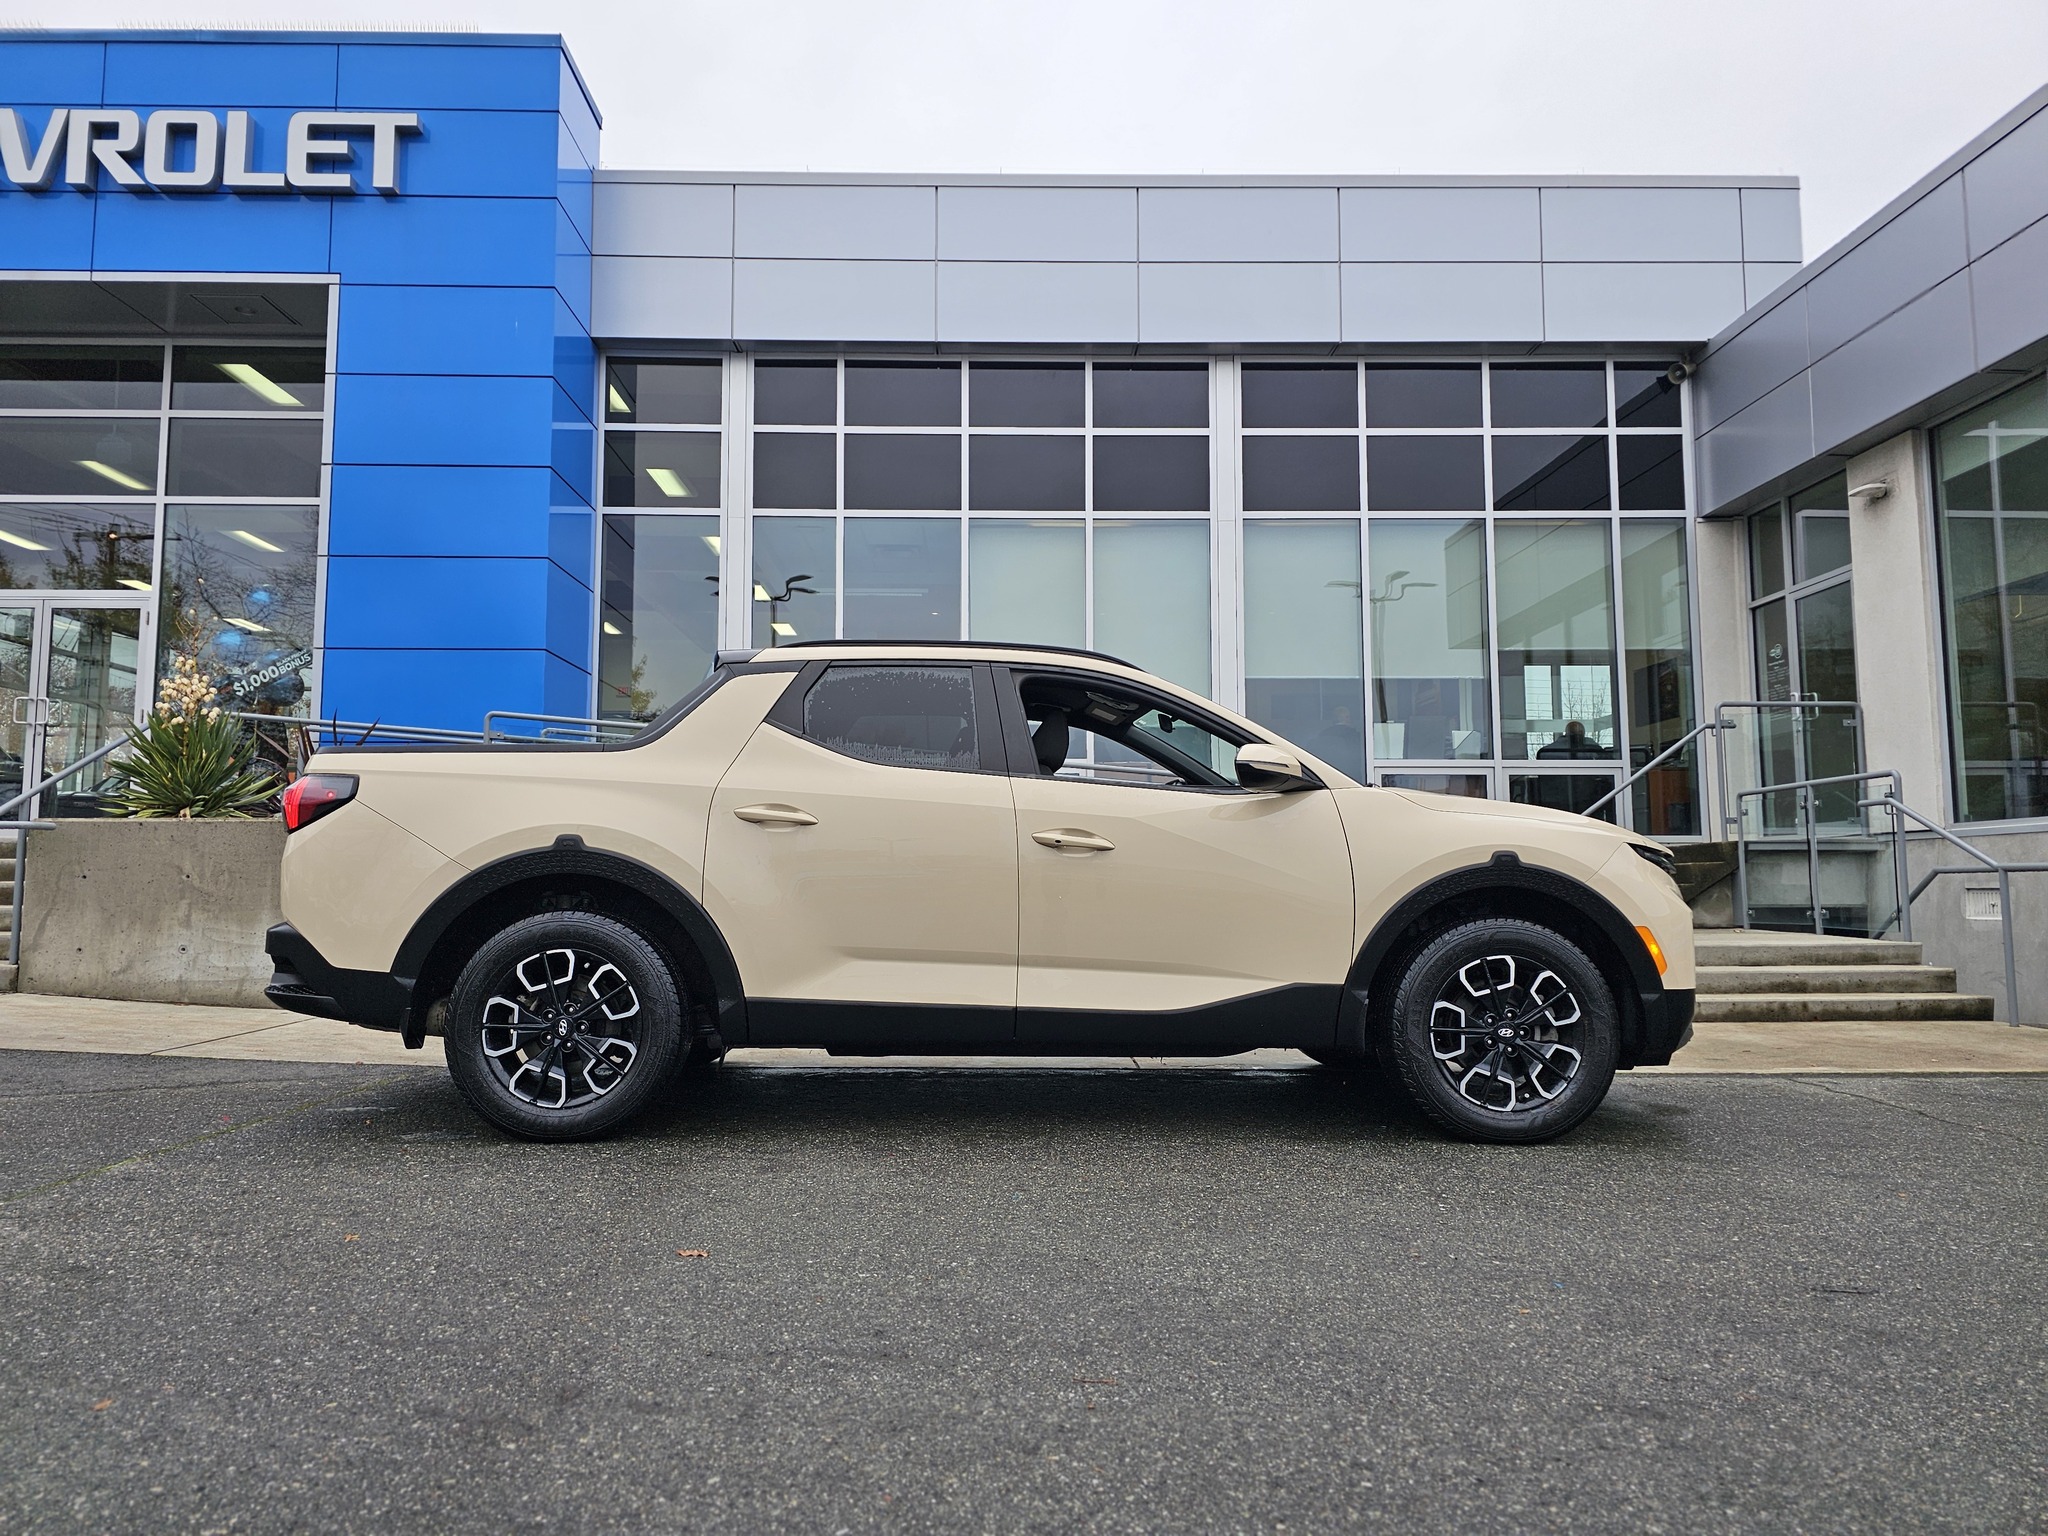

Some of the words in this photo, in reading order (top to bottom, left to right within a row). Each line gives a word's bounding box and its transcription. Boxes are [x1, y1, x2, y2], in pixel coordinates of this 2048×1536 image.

[276, 656, 291, 667] BLACK
[291, 649, 307, 660] FRIDAY
[233, 665, 279, 696] $1,000
[279, 653, 311, 674] BONUS
